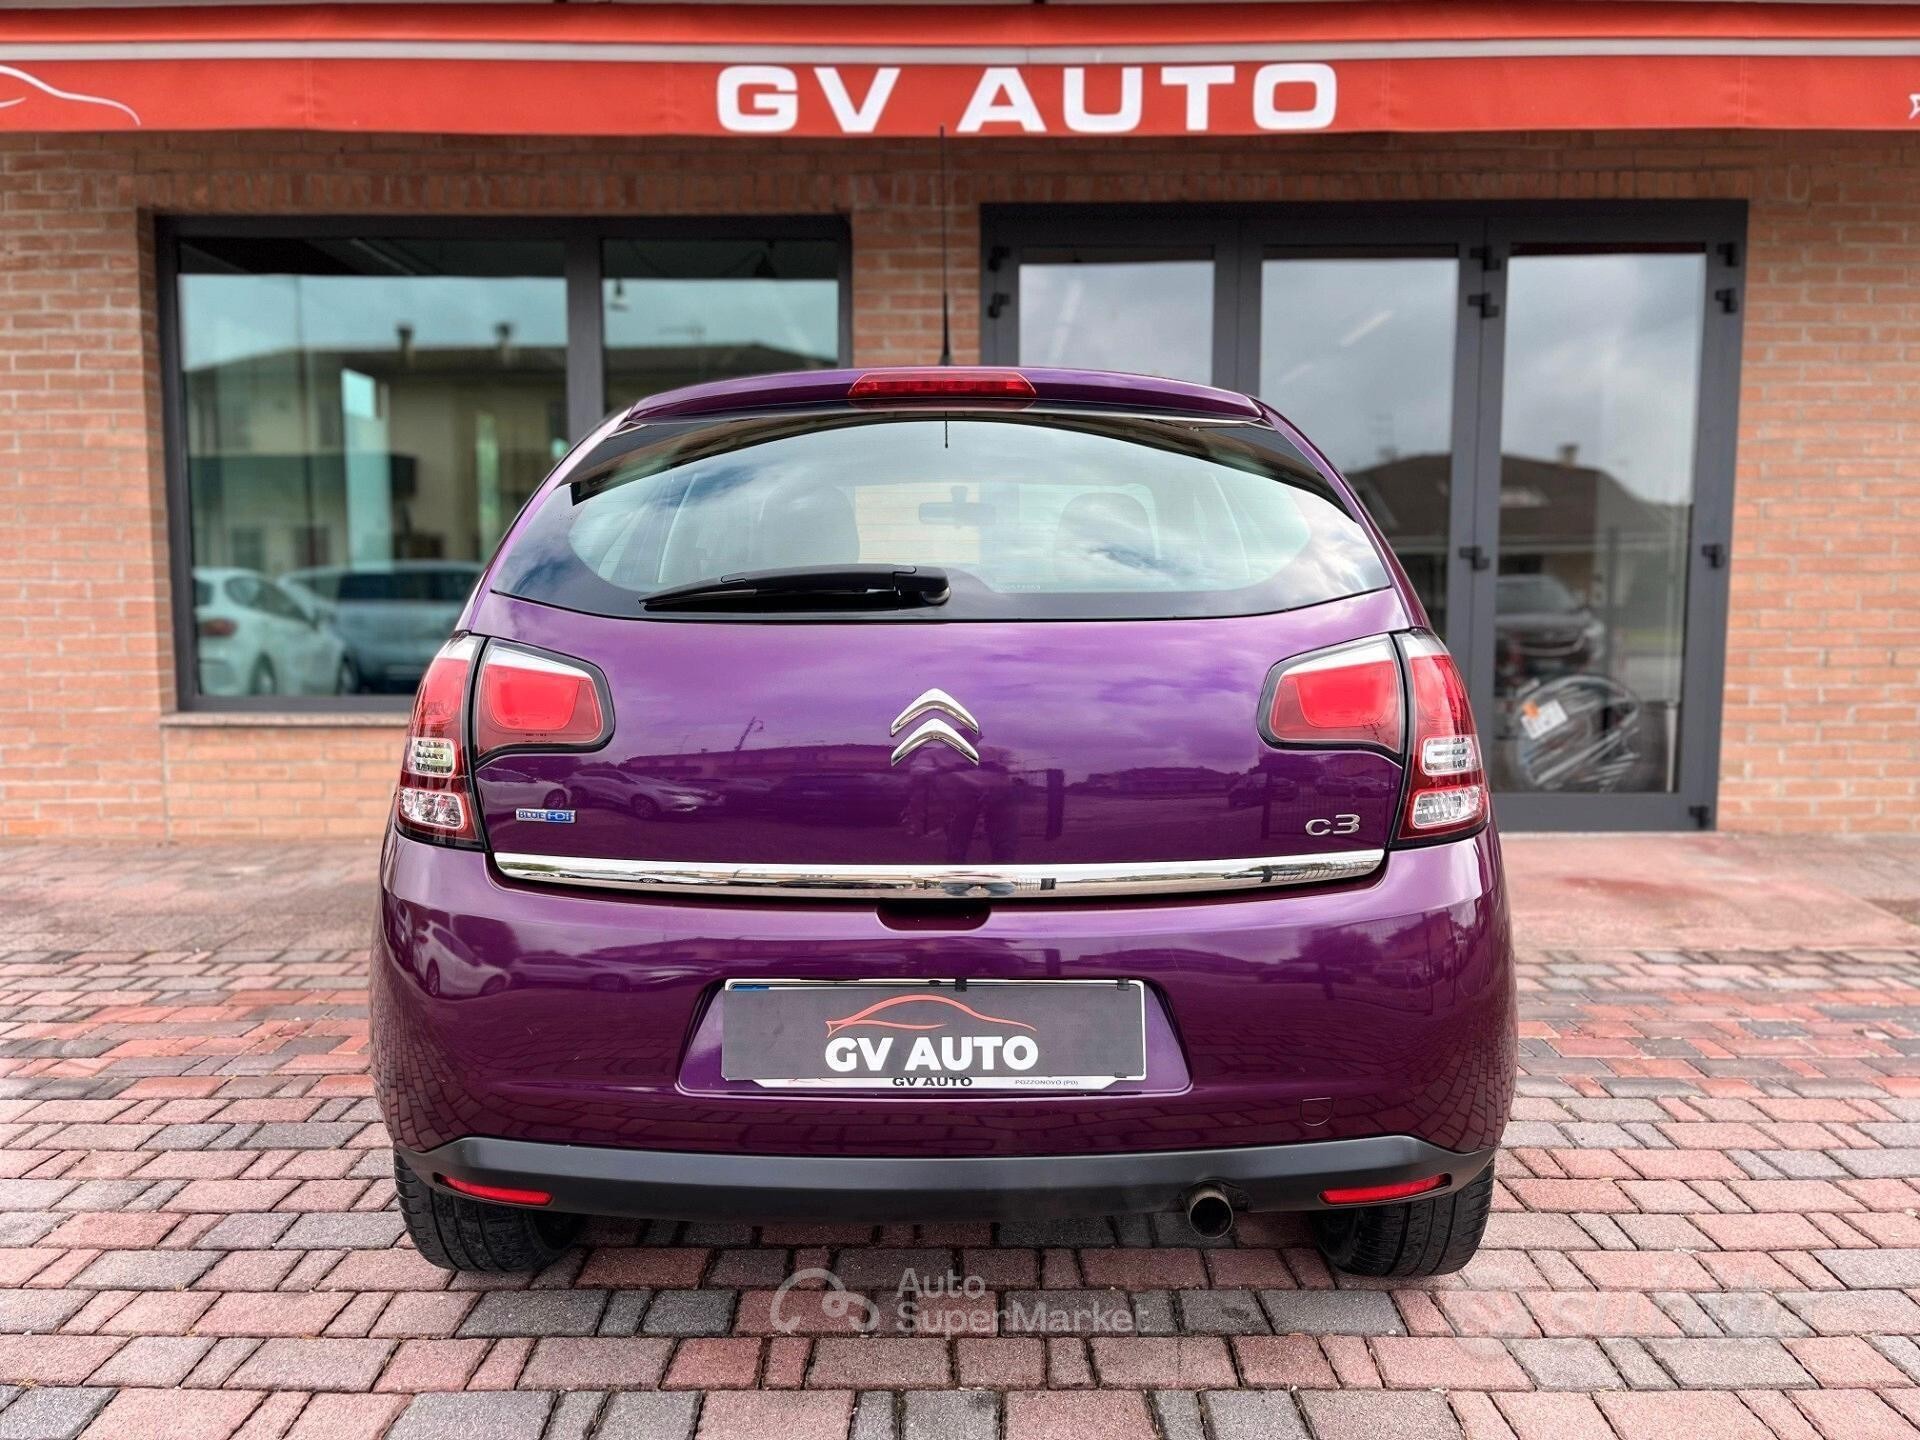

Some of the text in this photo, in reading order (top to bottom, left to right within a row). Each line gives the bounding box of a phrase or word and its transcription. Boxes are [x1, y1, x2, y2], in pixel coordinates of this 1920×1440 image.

[716, 63, 1337, 133] GV AUTO
[825, 1035, 1038, 1072] GV AUTO
[892, 1077, 973, 1087] GV AUTO
